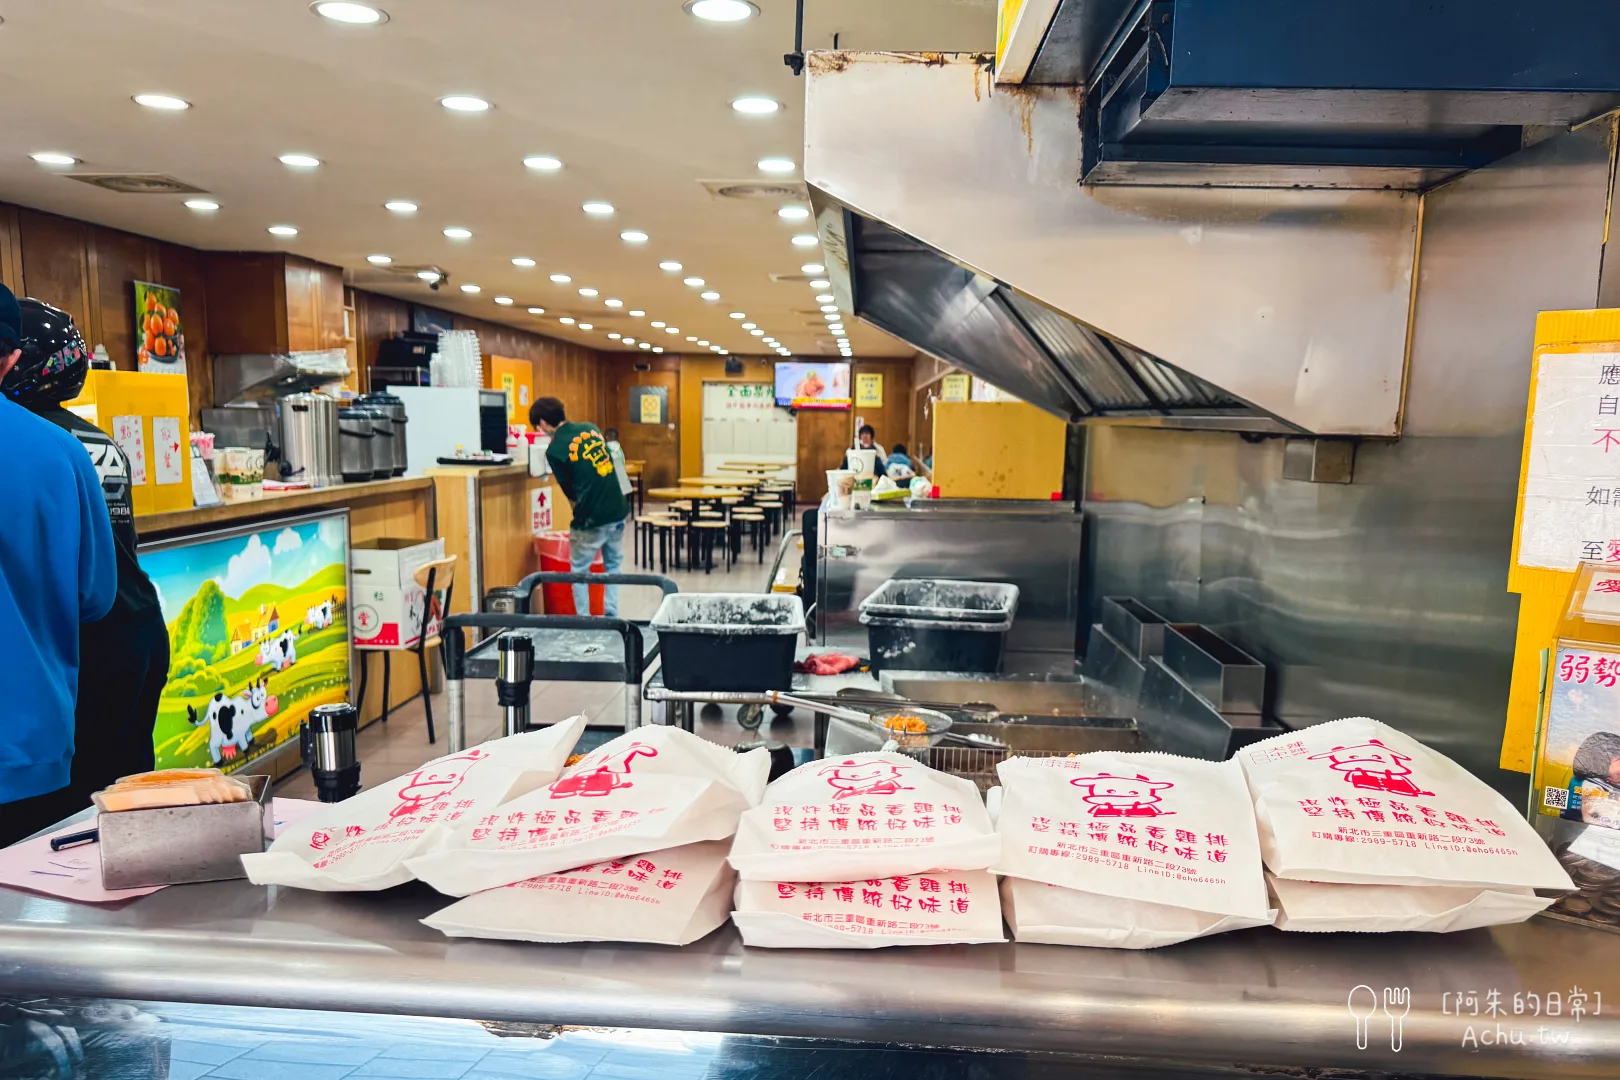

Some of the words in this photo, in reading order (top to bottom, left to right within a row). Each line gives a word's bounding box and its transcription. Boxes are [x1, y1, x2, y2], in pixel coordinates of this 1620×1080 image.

[773, 802, 964, 816] 現炸極品香雞排
[773, 815, 963, 832] 堅持傳統好味道
[777, 883, 971, 915] 堅持傳統好味道
